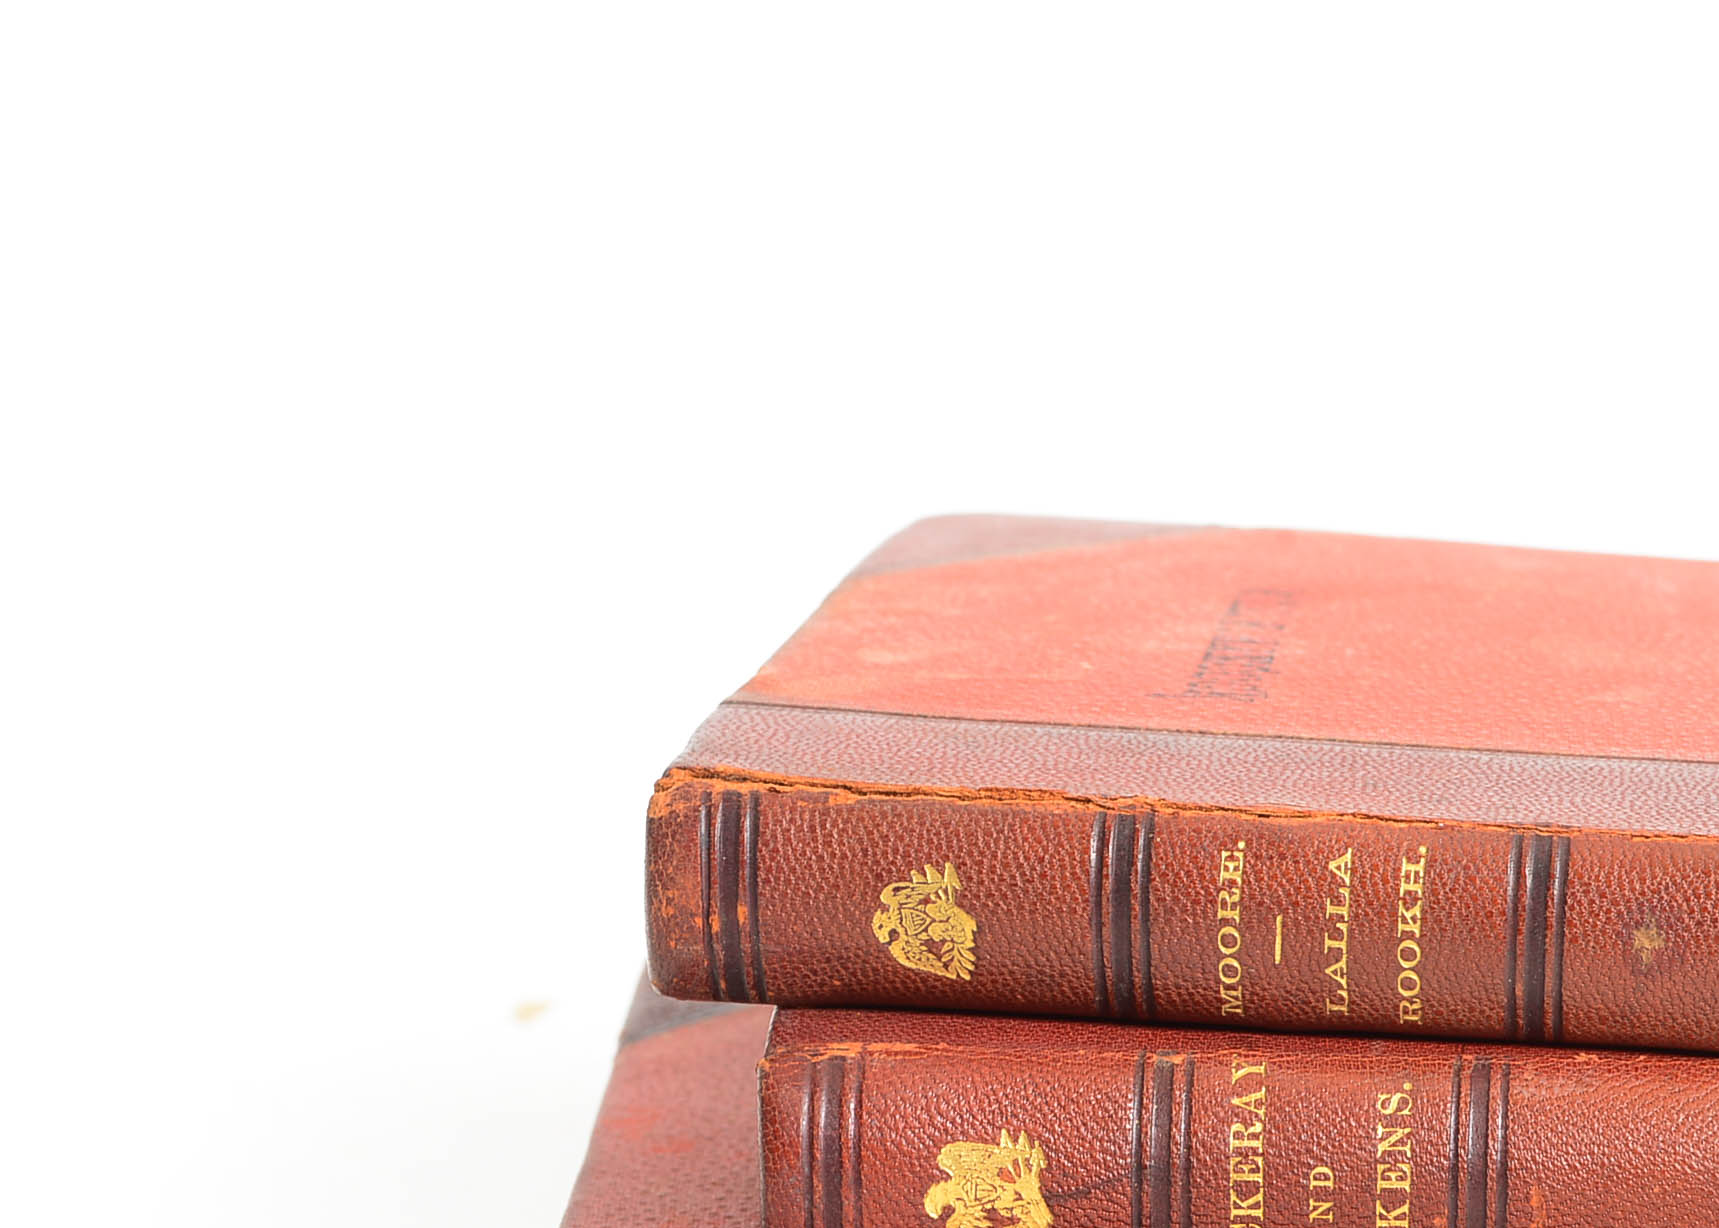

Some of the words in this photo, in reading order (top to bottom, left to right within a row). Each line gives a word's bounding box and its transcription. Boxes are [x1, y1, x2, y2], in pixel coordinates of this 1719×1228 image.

[1217, 840, 1246, 1017] MOORE.
[1324, 847, 1352, 1016] LALLA
[1397, 845, 1428, 1025] ROOKH.
